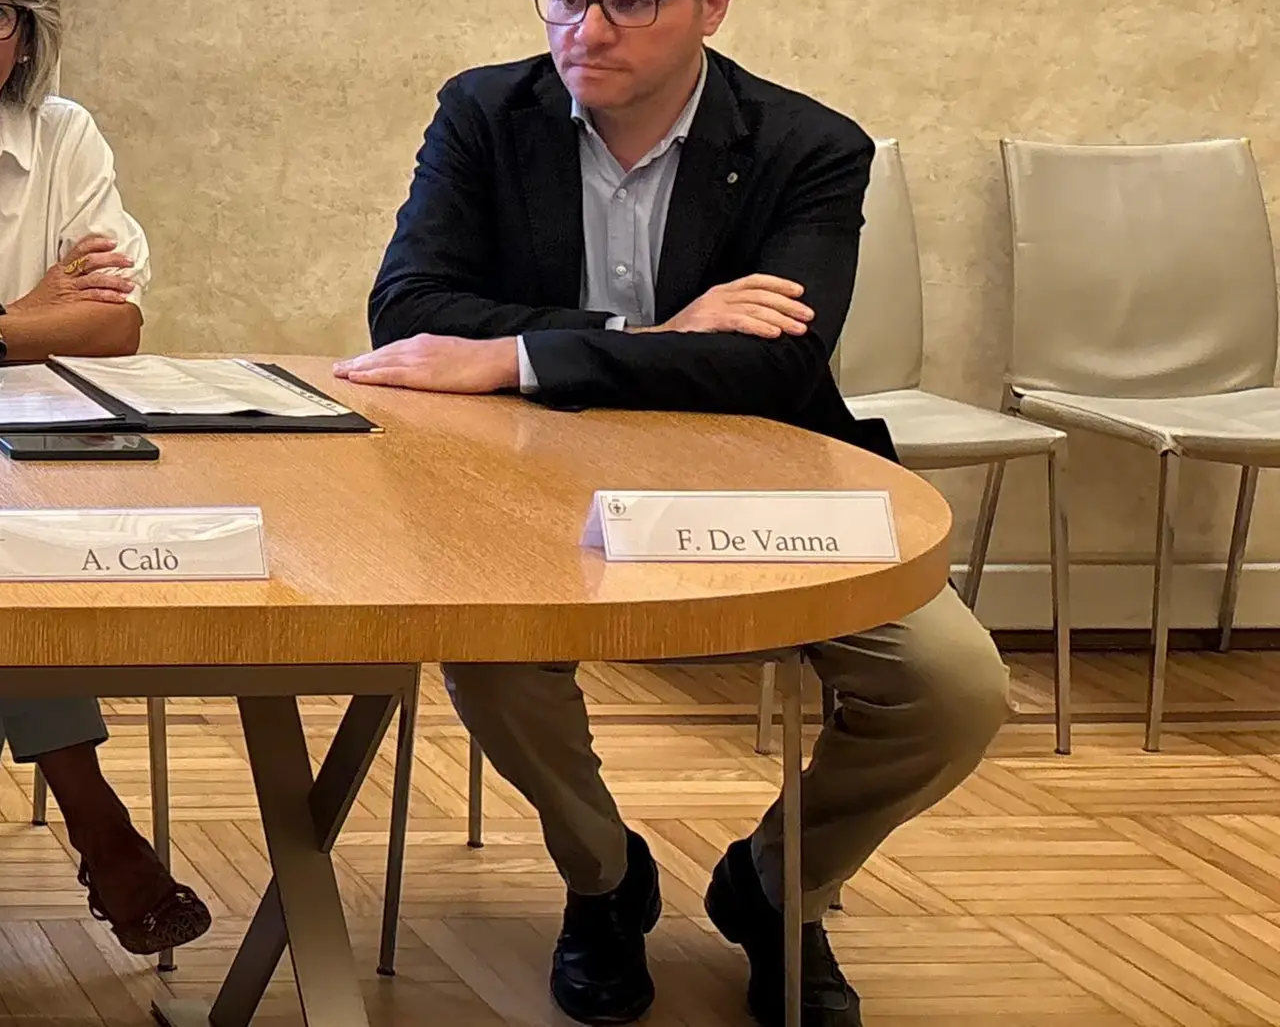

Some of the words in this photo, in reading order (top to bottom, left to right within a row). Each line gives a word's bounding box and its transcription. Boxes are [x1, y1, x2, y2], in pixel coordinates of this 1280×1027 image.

[676, 529, 701, 551] F.
[708, 529, 746, 552] De
[752, 529, 839, 552] Vanna
[81, 547, 111, 571] A.
[118, 547, 180, 571] Calò
